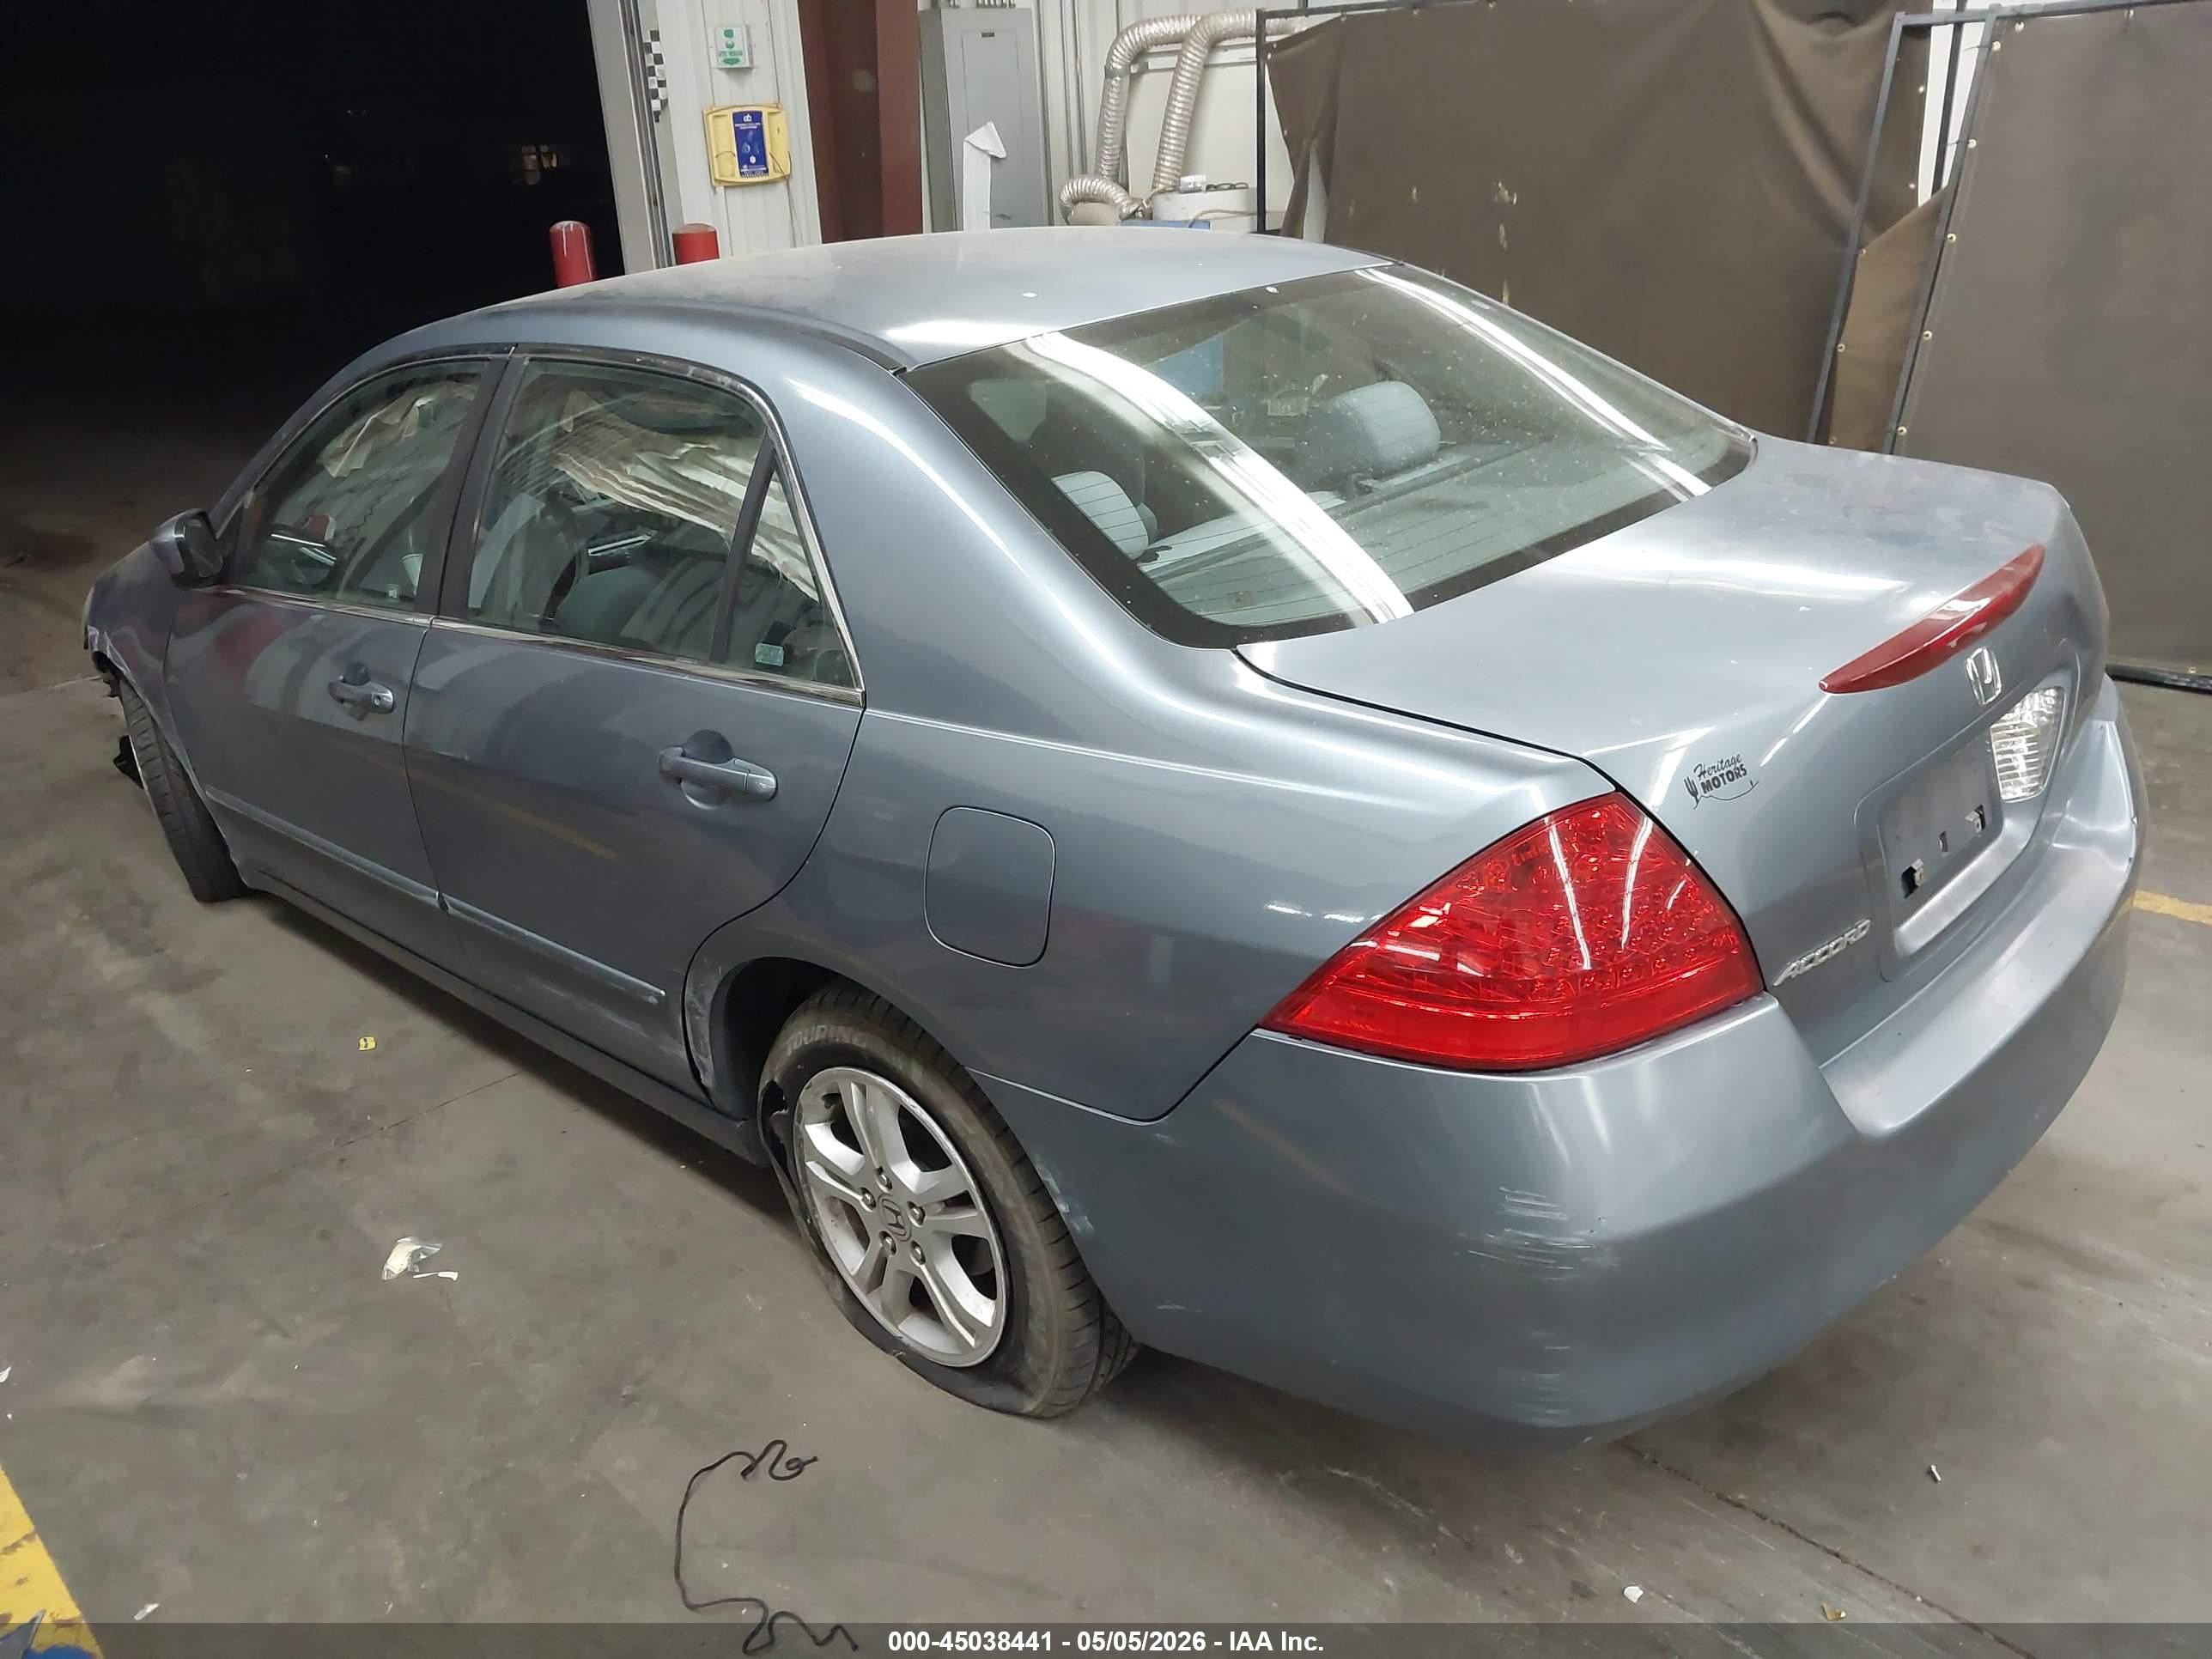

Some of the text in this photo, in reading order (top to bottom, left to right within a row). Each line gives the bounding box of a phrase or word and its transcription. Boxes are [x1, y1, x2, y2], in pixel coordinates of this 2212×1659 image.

[1693, 754, 1742, 781] Heritage
[1700, 763, 1747, 794] MOTORS
[1772, 919, 1871, 987] ACCORD
